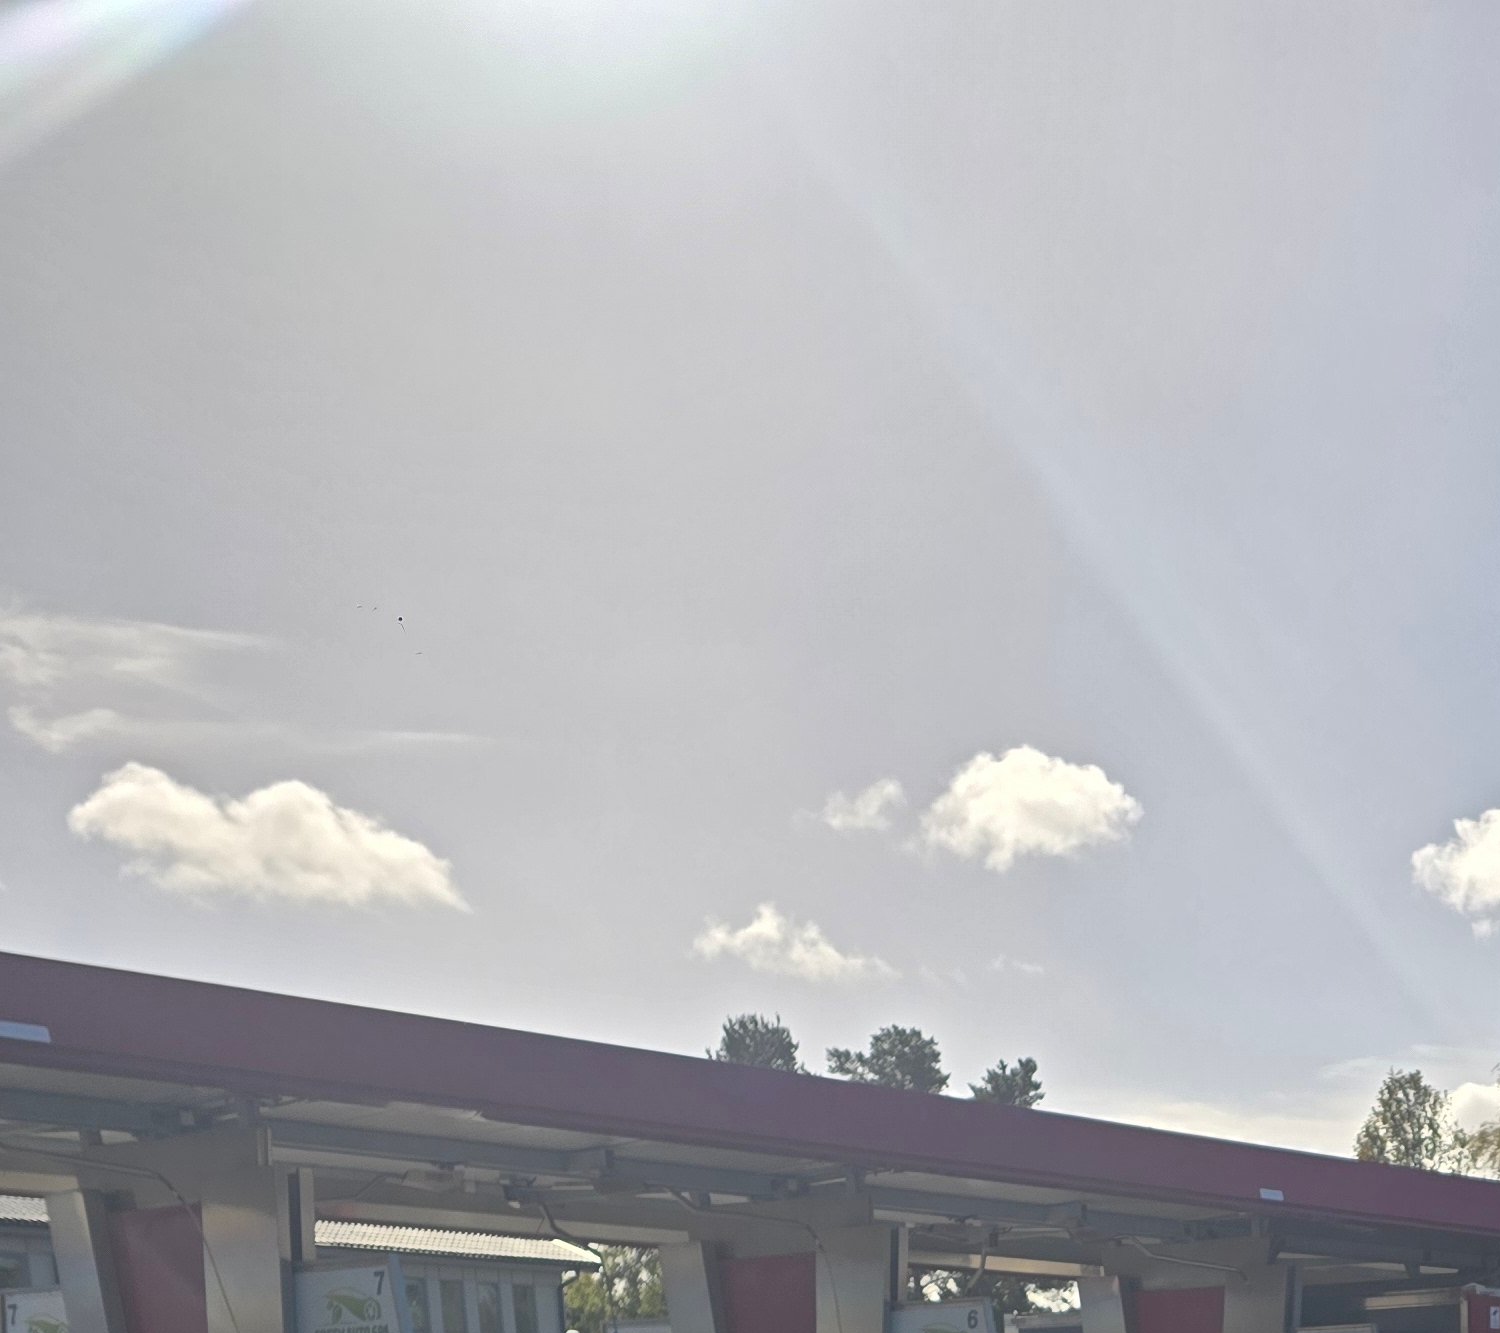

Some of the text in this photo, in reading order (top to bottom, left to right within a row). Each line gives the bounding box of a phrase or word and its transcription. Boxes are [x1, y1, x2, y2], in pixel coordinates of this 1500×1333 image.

[373, 1271, 385, 1296] 7
[7, 1304, 17, 1326] 7
[967, 1309, 979, 1329] 6
